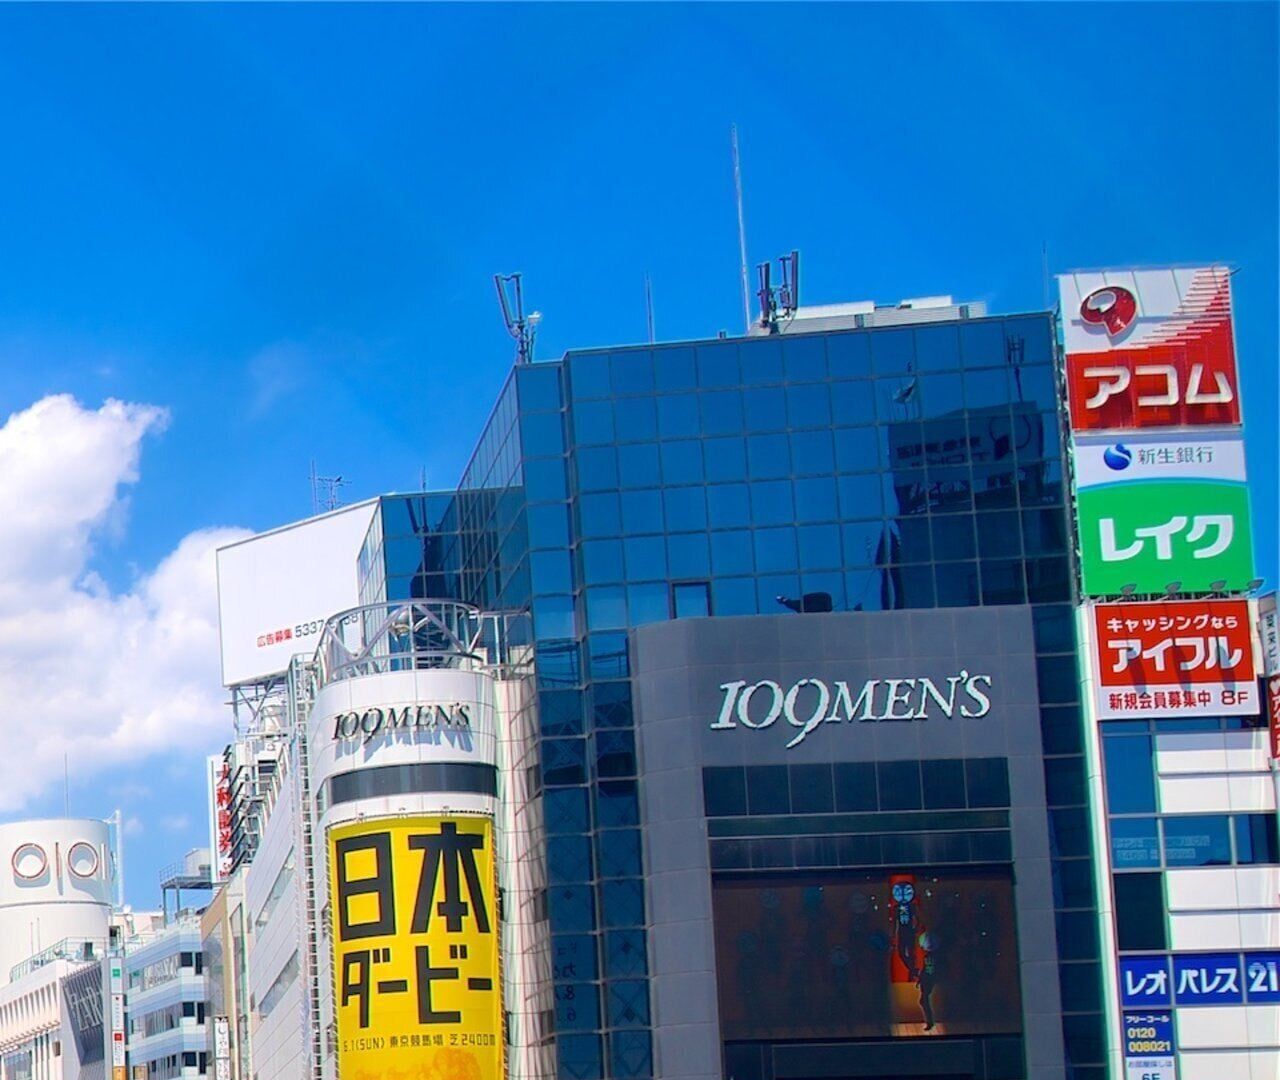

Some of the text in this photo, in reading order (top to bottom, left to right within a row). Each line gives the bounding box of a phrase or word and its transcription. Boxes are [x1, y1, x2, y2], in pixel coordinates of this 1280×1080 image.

[1083, 363, 1234, 409] アコム
[1138, 446, 1214, 465] 新生銀行
[1098, 514, 1235, 562] レイク
[1106, 613, 1239, 633] キャッシングなら
[1107, 635, 1243, 674] アイフル
[1108, 689, 1249, 711] 新規会員募集中 8F
[335, 821, 491, 942] 日本
[342, 944, 493, 1029] ダービー
[1126, 1015, 1170, 1024] フリーコール
[390, 1034, 444, 1048] 東京競馬場
[1127, 1027, 1156, 1039] 0120
[1128, 1041, 1171, 1053] 008021
